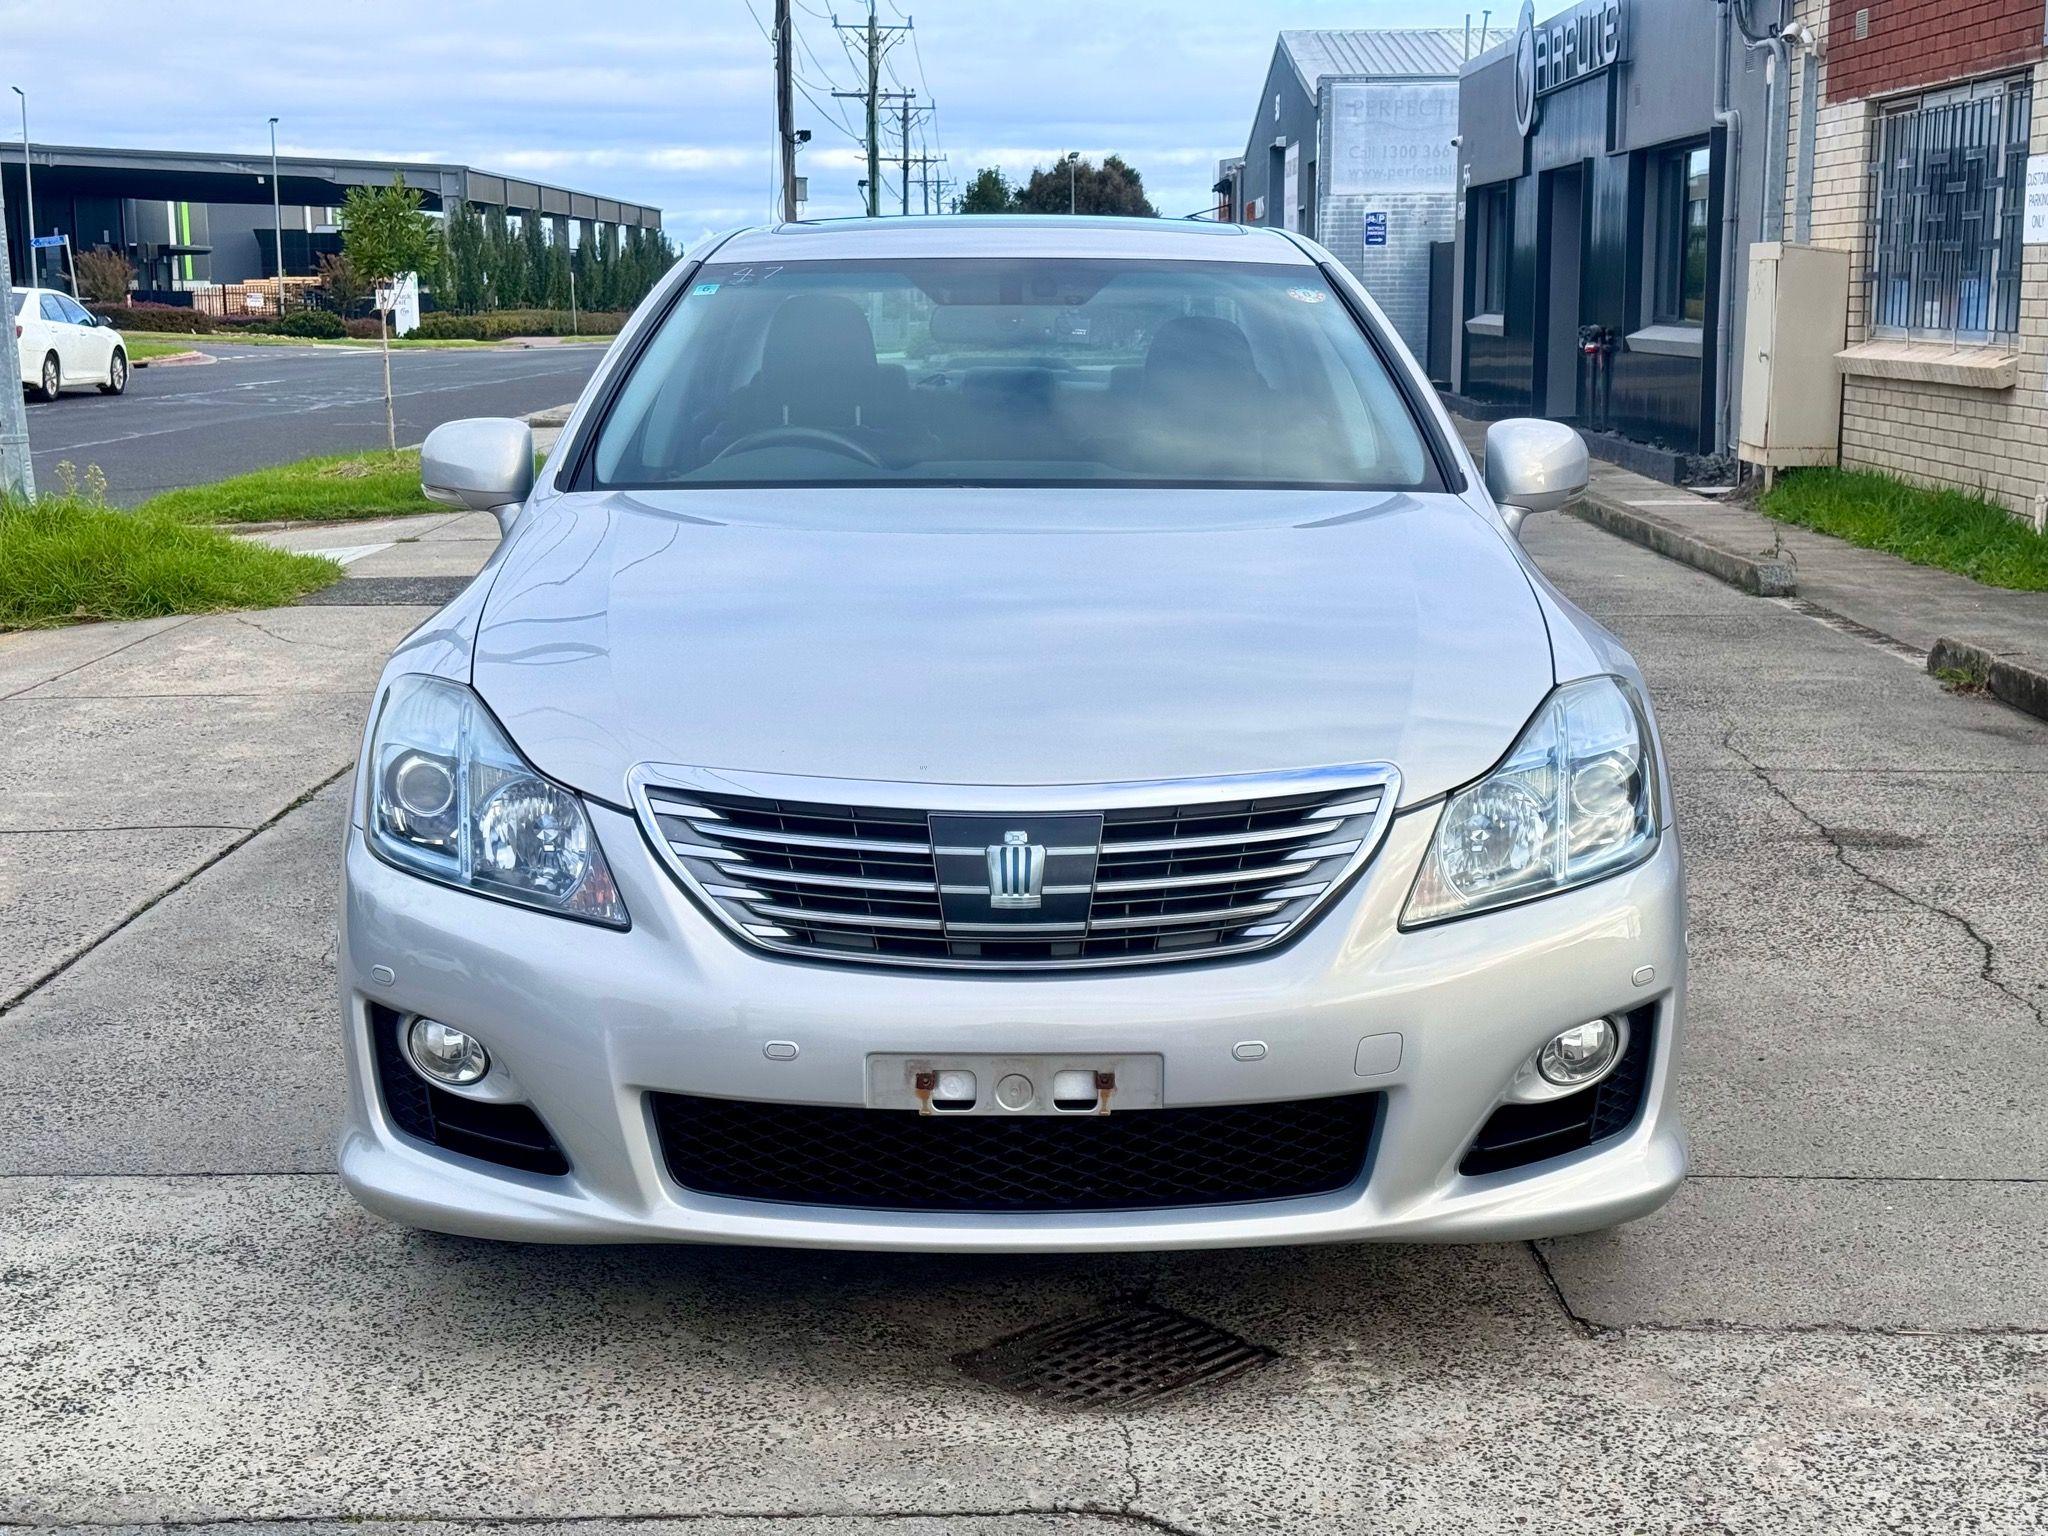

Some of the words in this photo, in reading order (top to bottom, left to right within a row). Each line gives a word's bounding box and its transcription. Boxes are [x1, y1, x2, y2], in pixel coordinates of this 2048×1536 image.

[1536, 0, 1620, 93] AIRFLITE
[1348, 145, 1375, 159] Call
[1382, 145, 1417, 159] 1300
[1422, 145, 1450, 158] 366
[2031, 214, 2046, 228] ONLY
